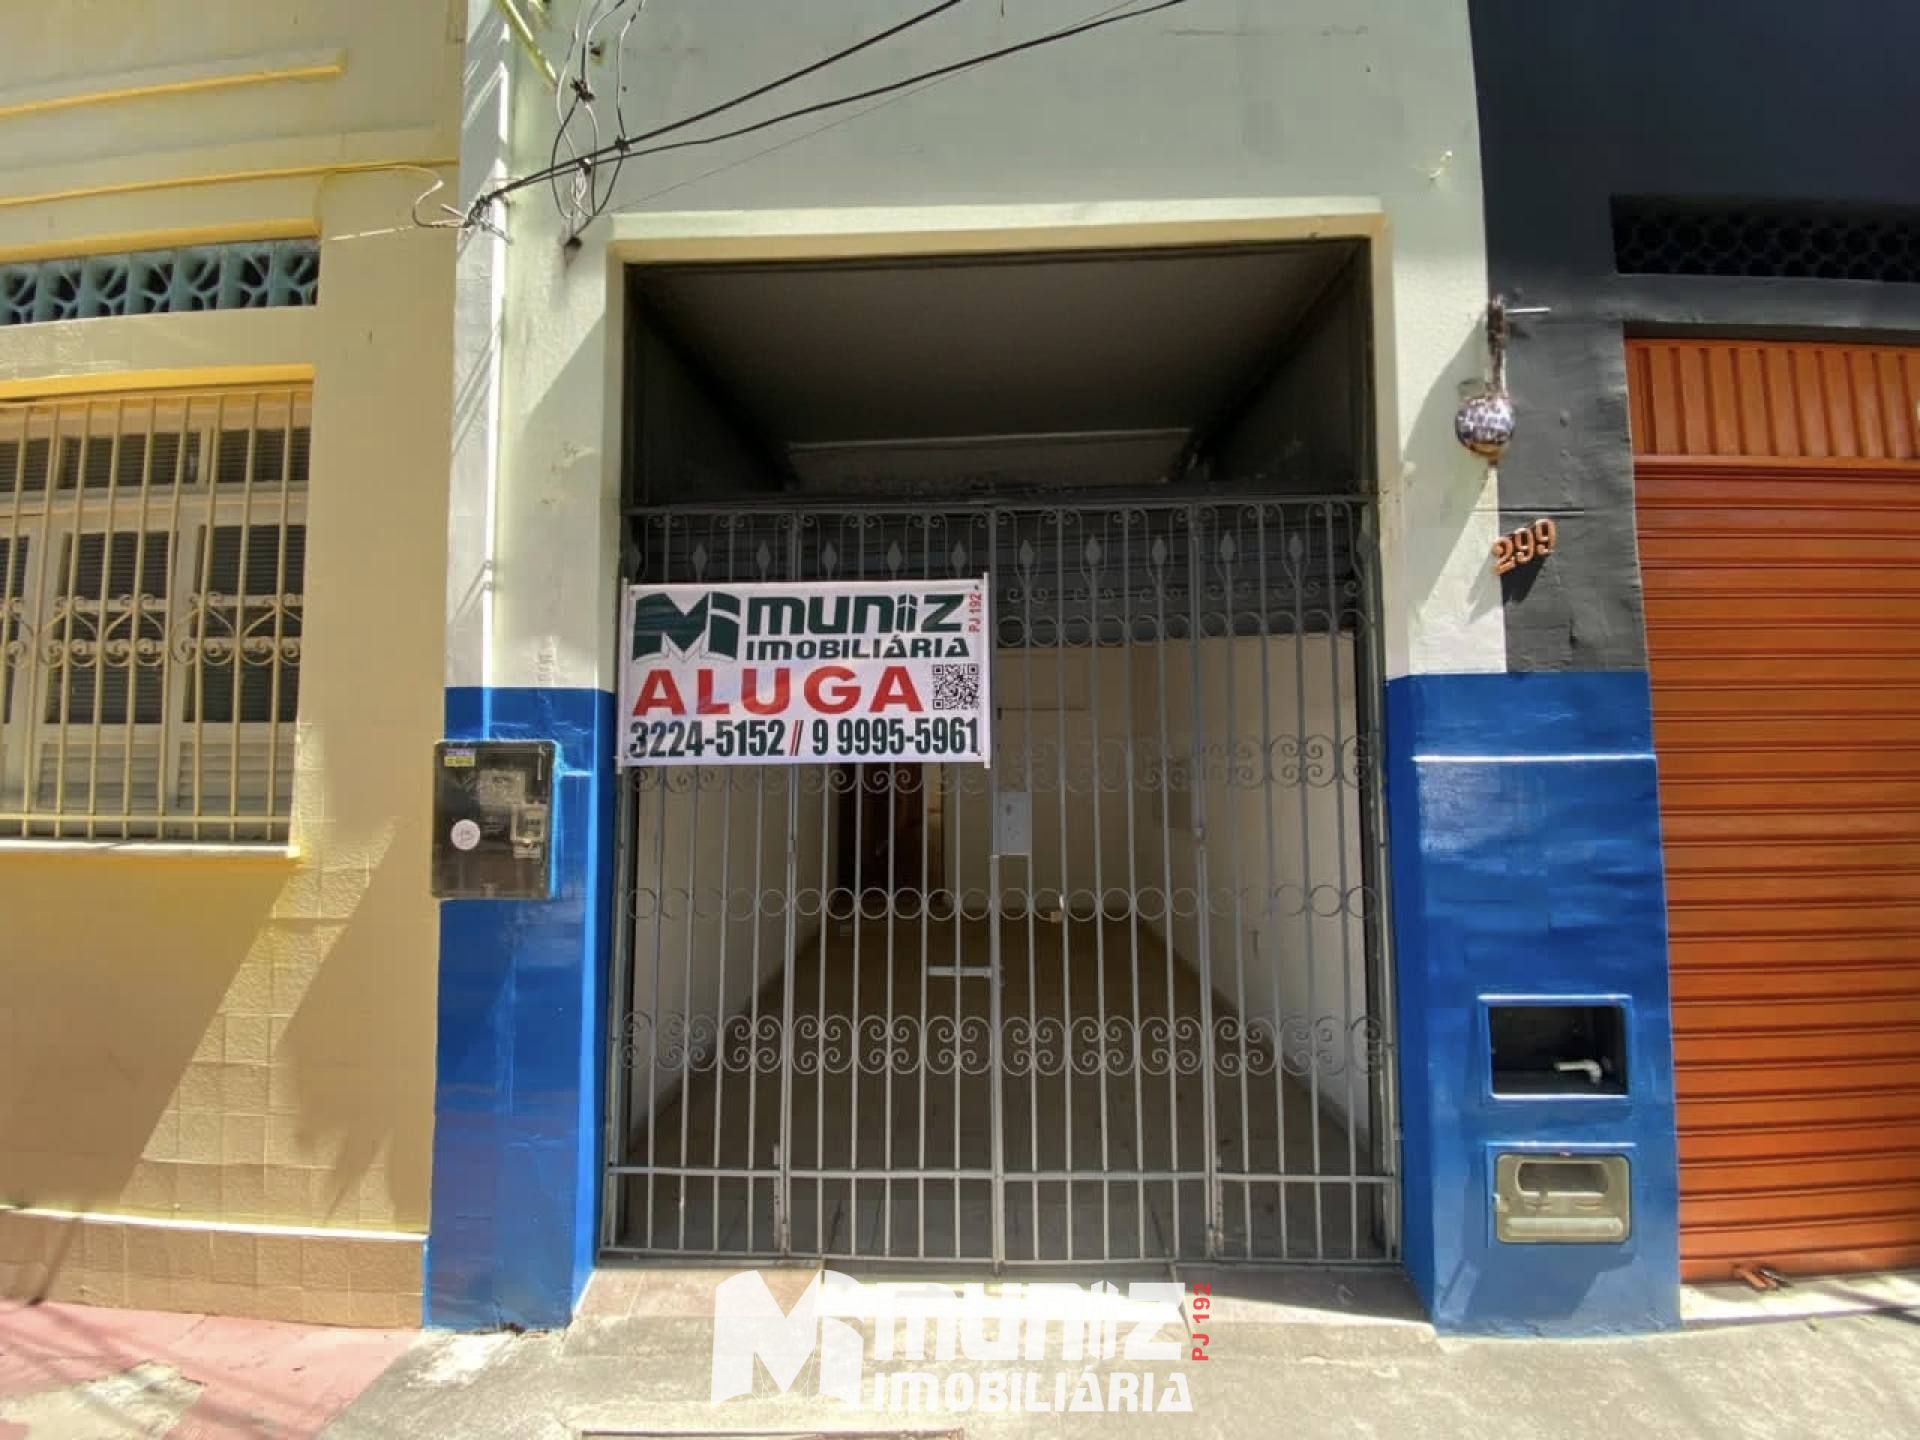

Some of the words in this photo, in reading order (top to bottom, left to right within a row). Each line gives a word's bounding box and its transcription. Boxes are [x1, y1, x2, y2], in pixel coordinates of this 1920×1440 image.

[1491, 518, 1557, 576] 299
[632, 665, 924, 716] ALUGA
[629, 719, 785, 757] 3224-5152
[812, 722, 829, 756] 9
[837, 717, 978, 755] 9995-5961
